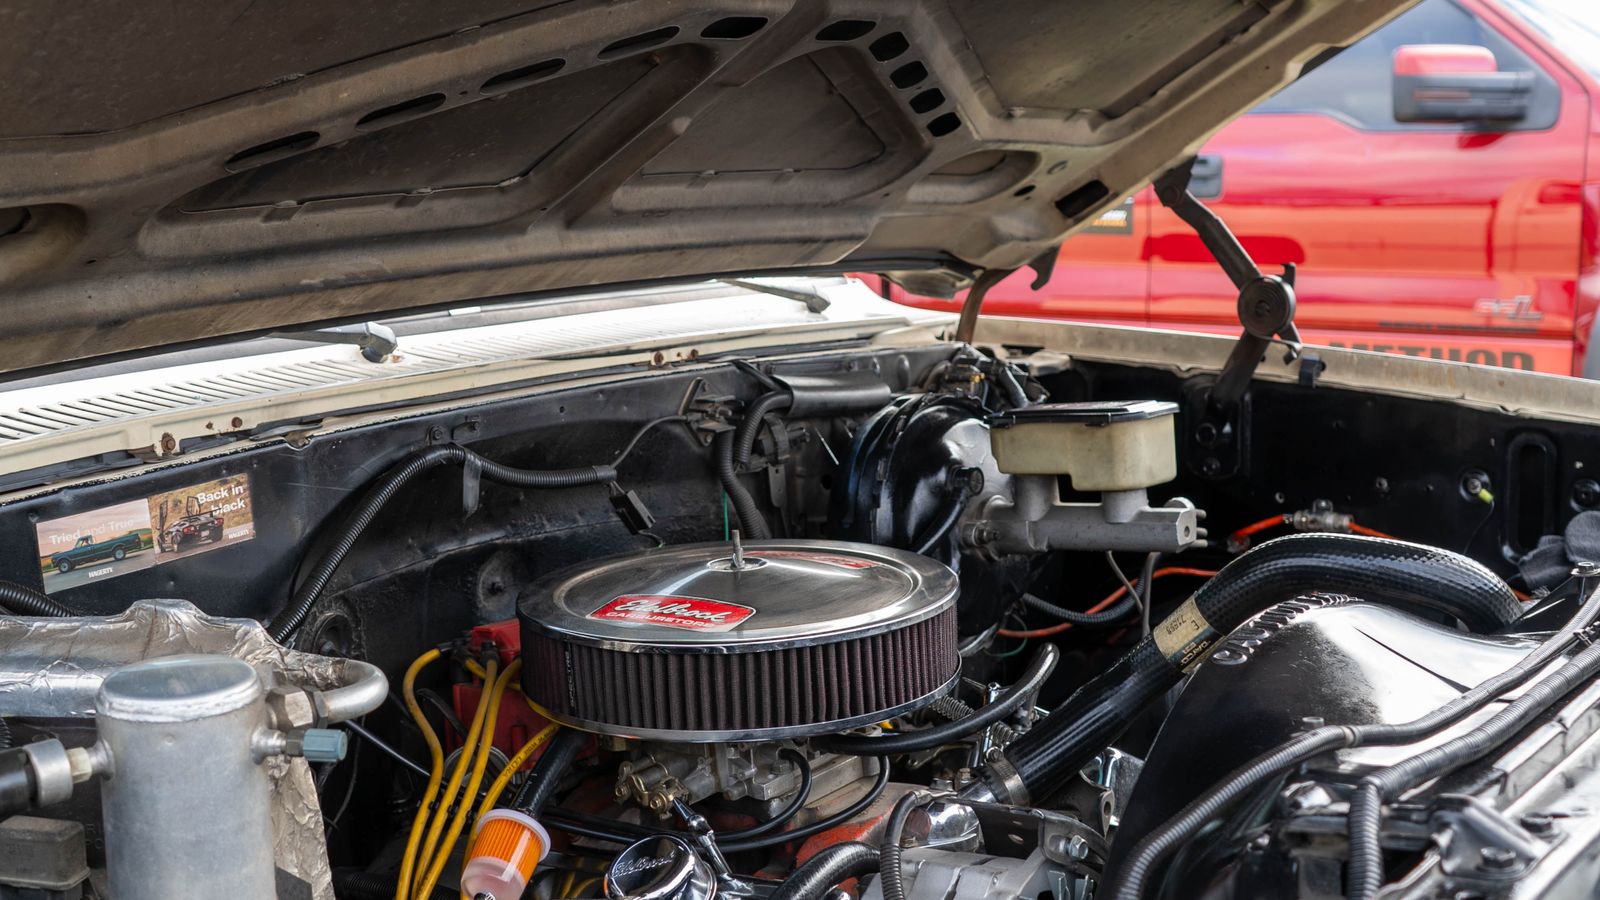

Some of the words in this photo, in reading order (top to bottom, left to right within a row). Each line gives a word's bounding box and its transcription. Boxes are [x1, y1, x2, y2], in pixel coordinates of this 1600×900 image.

[197, 487, 229, 504] Back
[231, 484, 244, 495] in
[211, 498, 246, 515] black
[49, 529, 81, 545] Tried
[85, 523, 105, 536] and
[107, 519, 135, 532] True
[614, 599, 732, 622] Edelbrock
